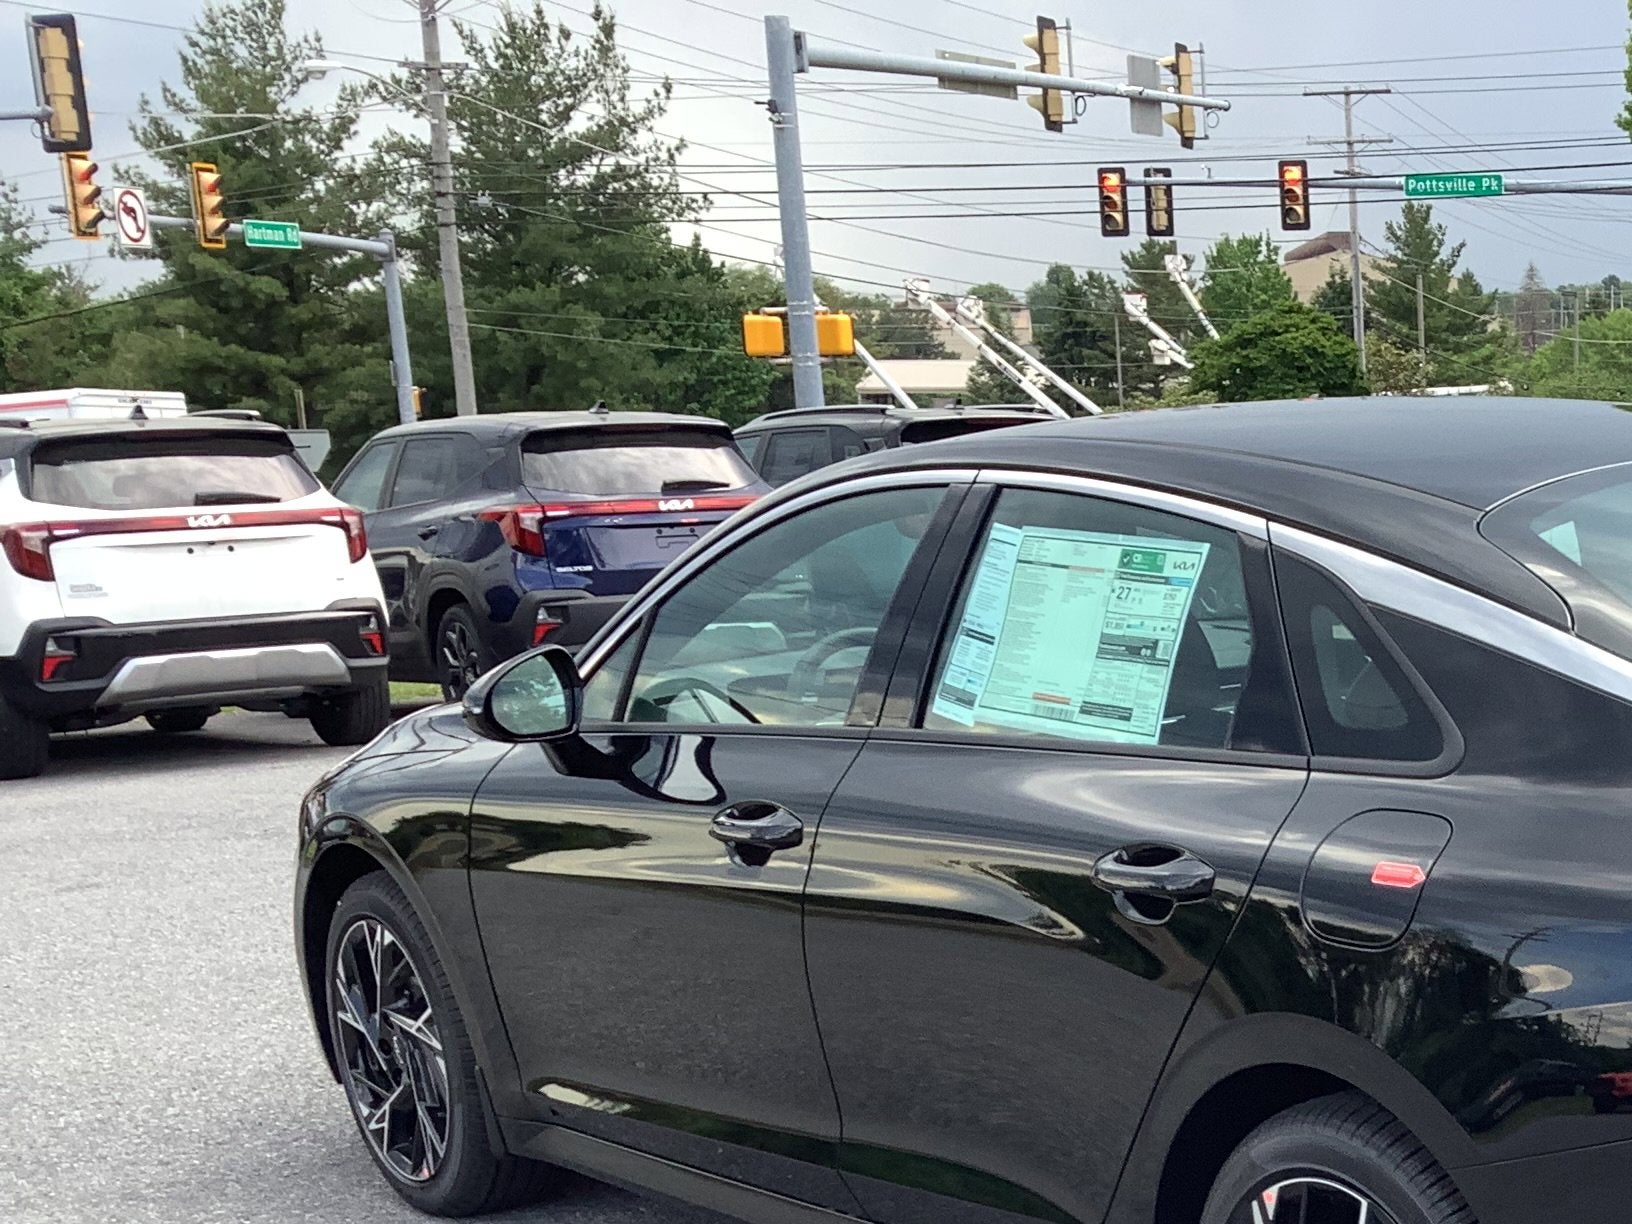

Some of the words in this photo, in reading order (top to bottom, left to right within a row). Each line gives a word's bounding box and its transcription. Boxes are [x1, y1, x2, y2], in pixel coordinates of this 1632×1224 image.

[1407, 178, 1476, 193] Pottsville
[1481, 177, 1499, 191] Pk
[1172, 560, 1197, 571] KIA
[1115, 585, 1132, 601] 27
